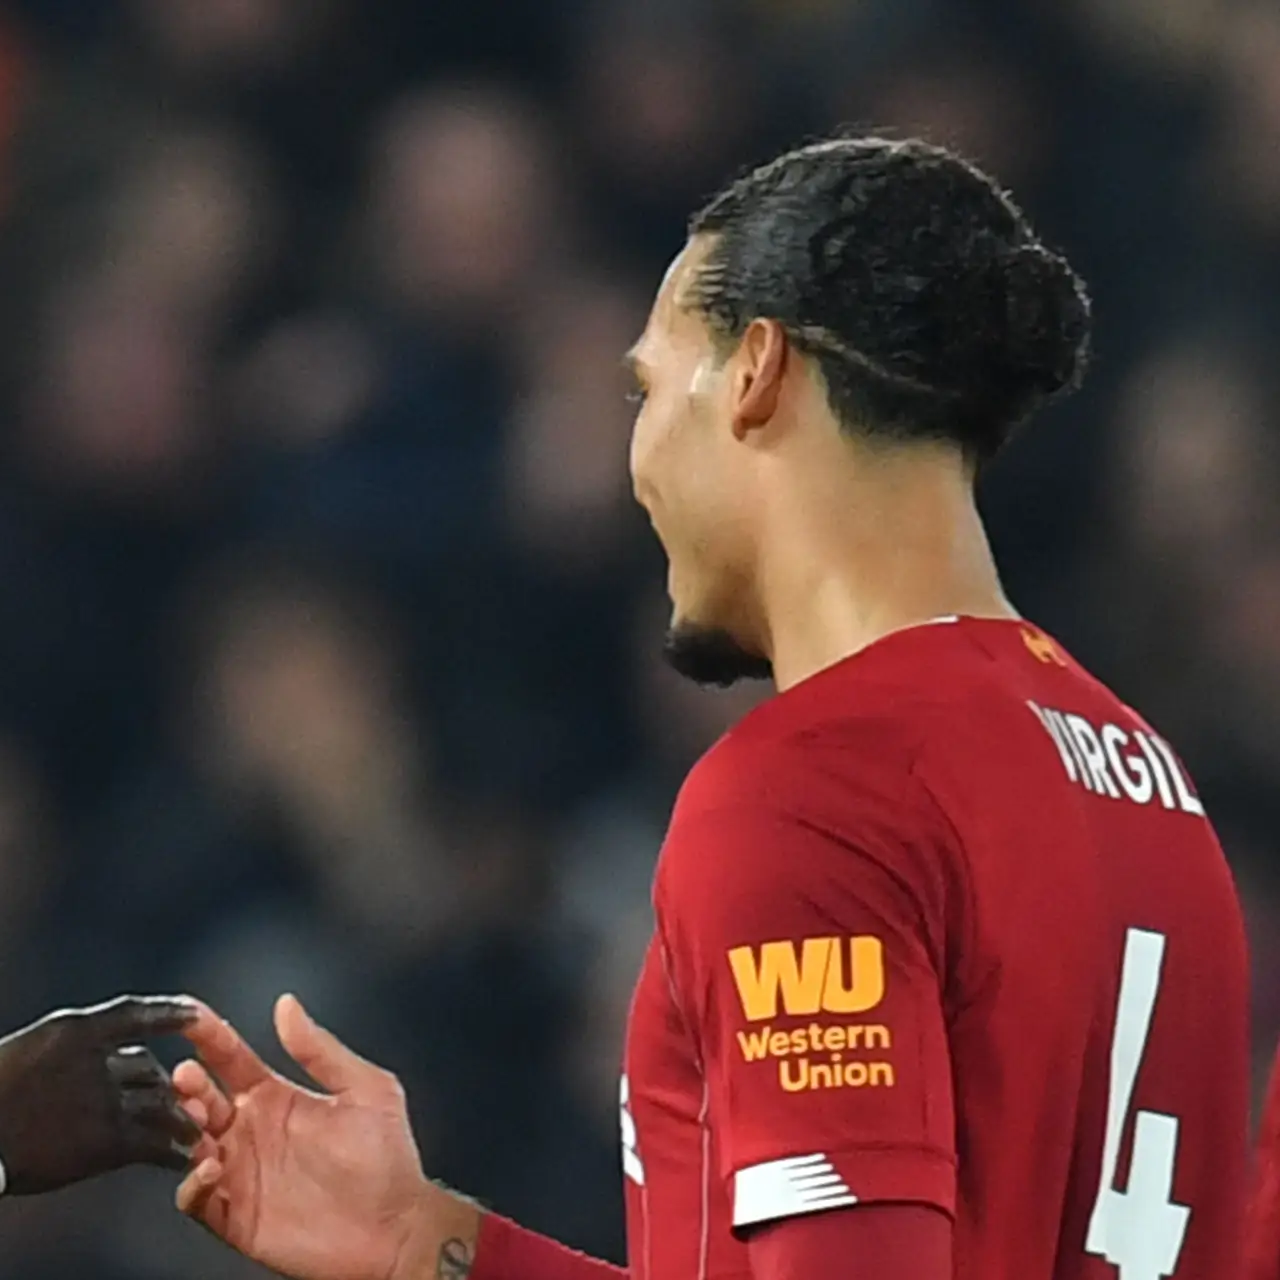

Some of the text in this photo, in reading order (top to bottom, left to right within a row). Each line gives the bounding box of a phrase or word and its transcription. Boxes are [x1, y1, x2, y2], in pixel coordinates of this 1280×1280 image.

[728, 935, 885, 1022] WU
[736, 1023, 892, 1062] Western
[779, 1053, 895, 1092] Union
